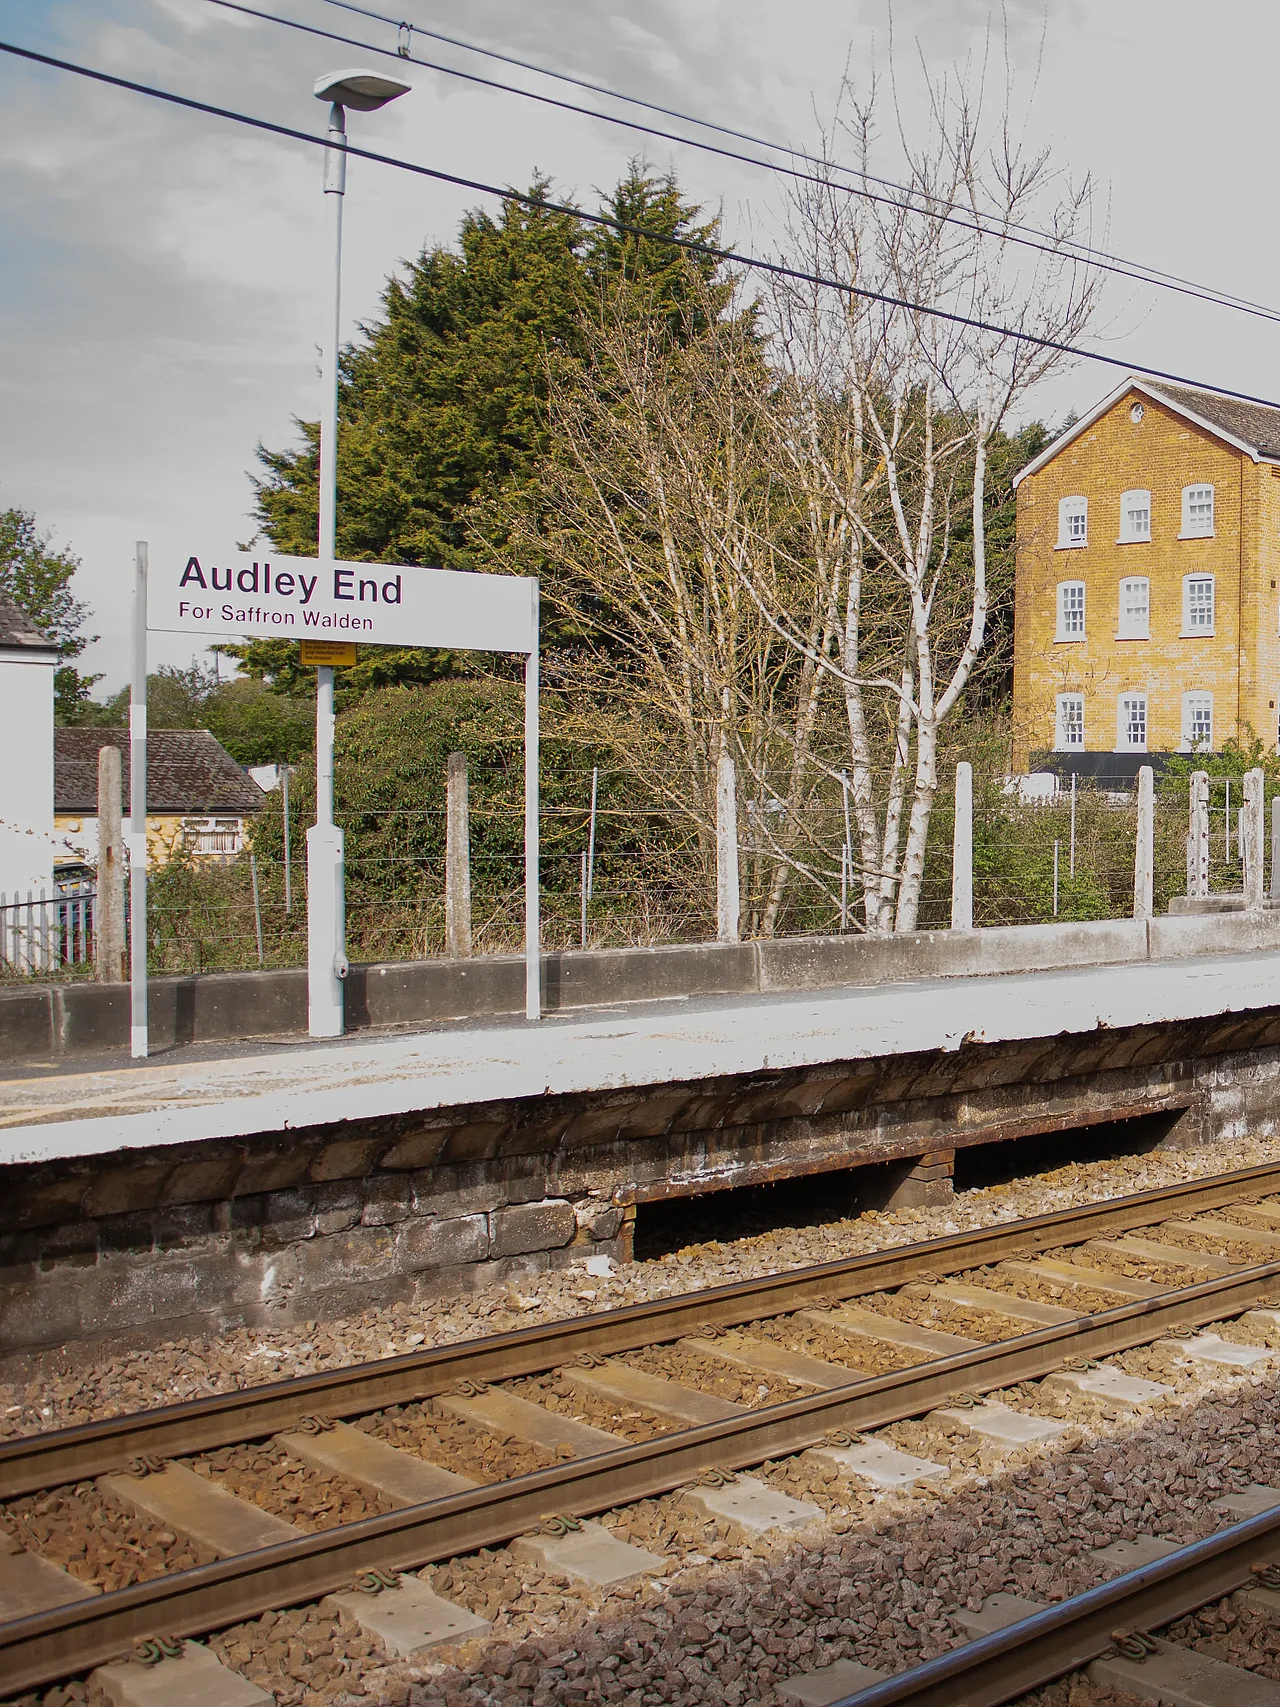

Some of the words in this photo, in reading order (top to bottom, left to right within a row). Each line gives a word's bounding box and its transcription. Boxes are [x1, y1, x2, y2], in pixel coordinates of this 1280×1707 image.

[179, 556, 317, 605] Audley
[333, 569, 402, 604] End
[179, 602, 214, 619] For
[221, 604, 295, 625] Saffron
[302, 610, 373, 630] Walden
